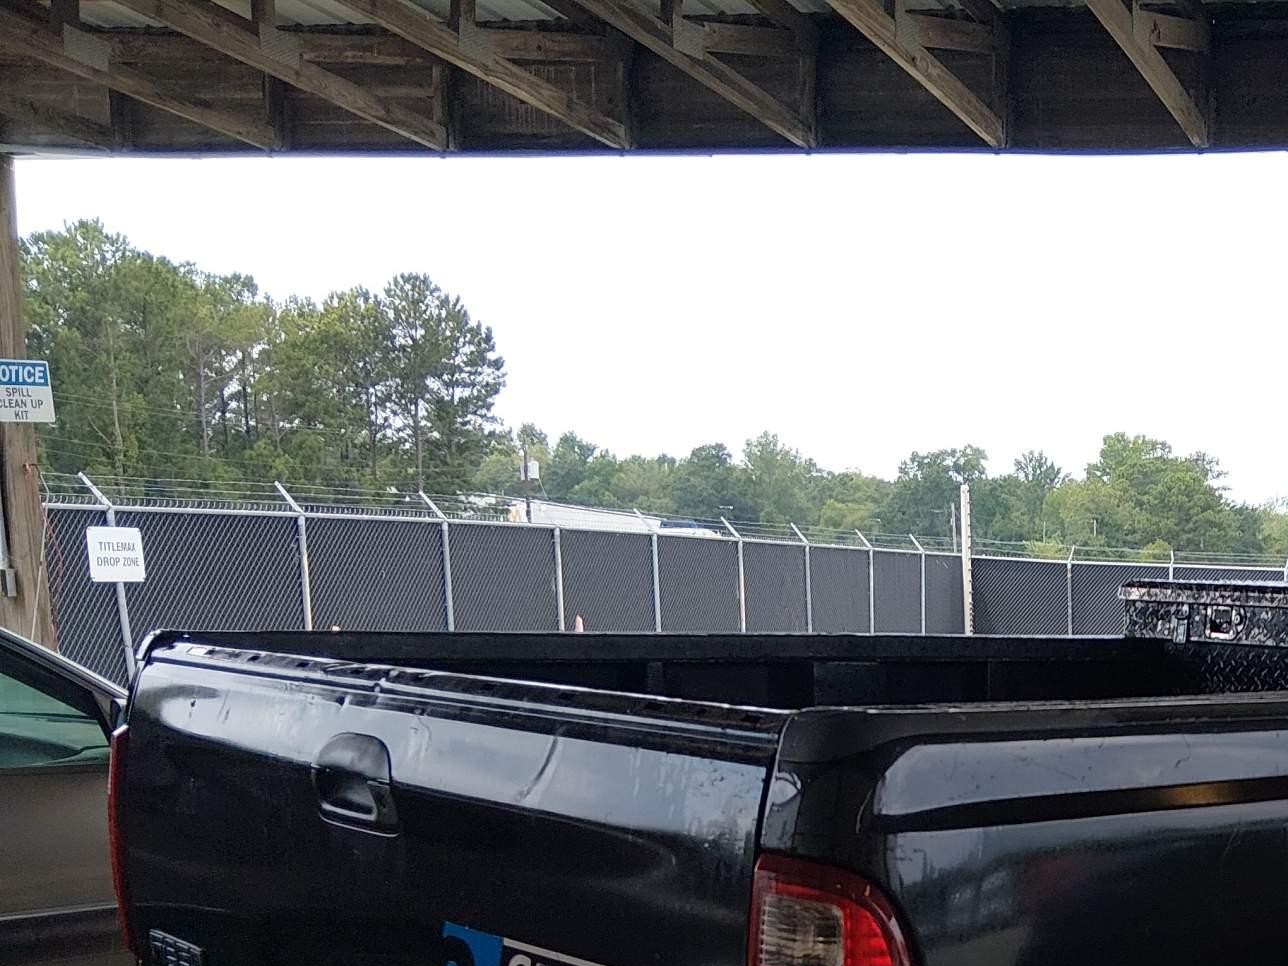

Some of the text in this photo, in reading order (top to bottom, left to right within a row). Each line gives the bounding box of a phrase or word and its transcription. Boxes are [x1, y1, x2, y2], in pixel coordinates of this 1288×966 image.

[0, 365, 45, 383] OTICE
[5, 387, 32, 397] SPILL
[31, 399, 44, 409] UP
[14, 410, 29, 420] KIT
[97, 541, 136, 552] TITLEMAX
[96, 556, 140, 567] DROP ZONE
